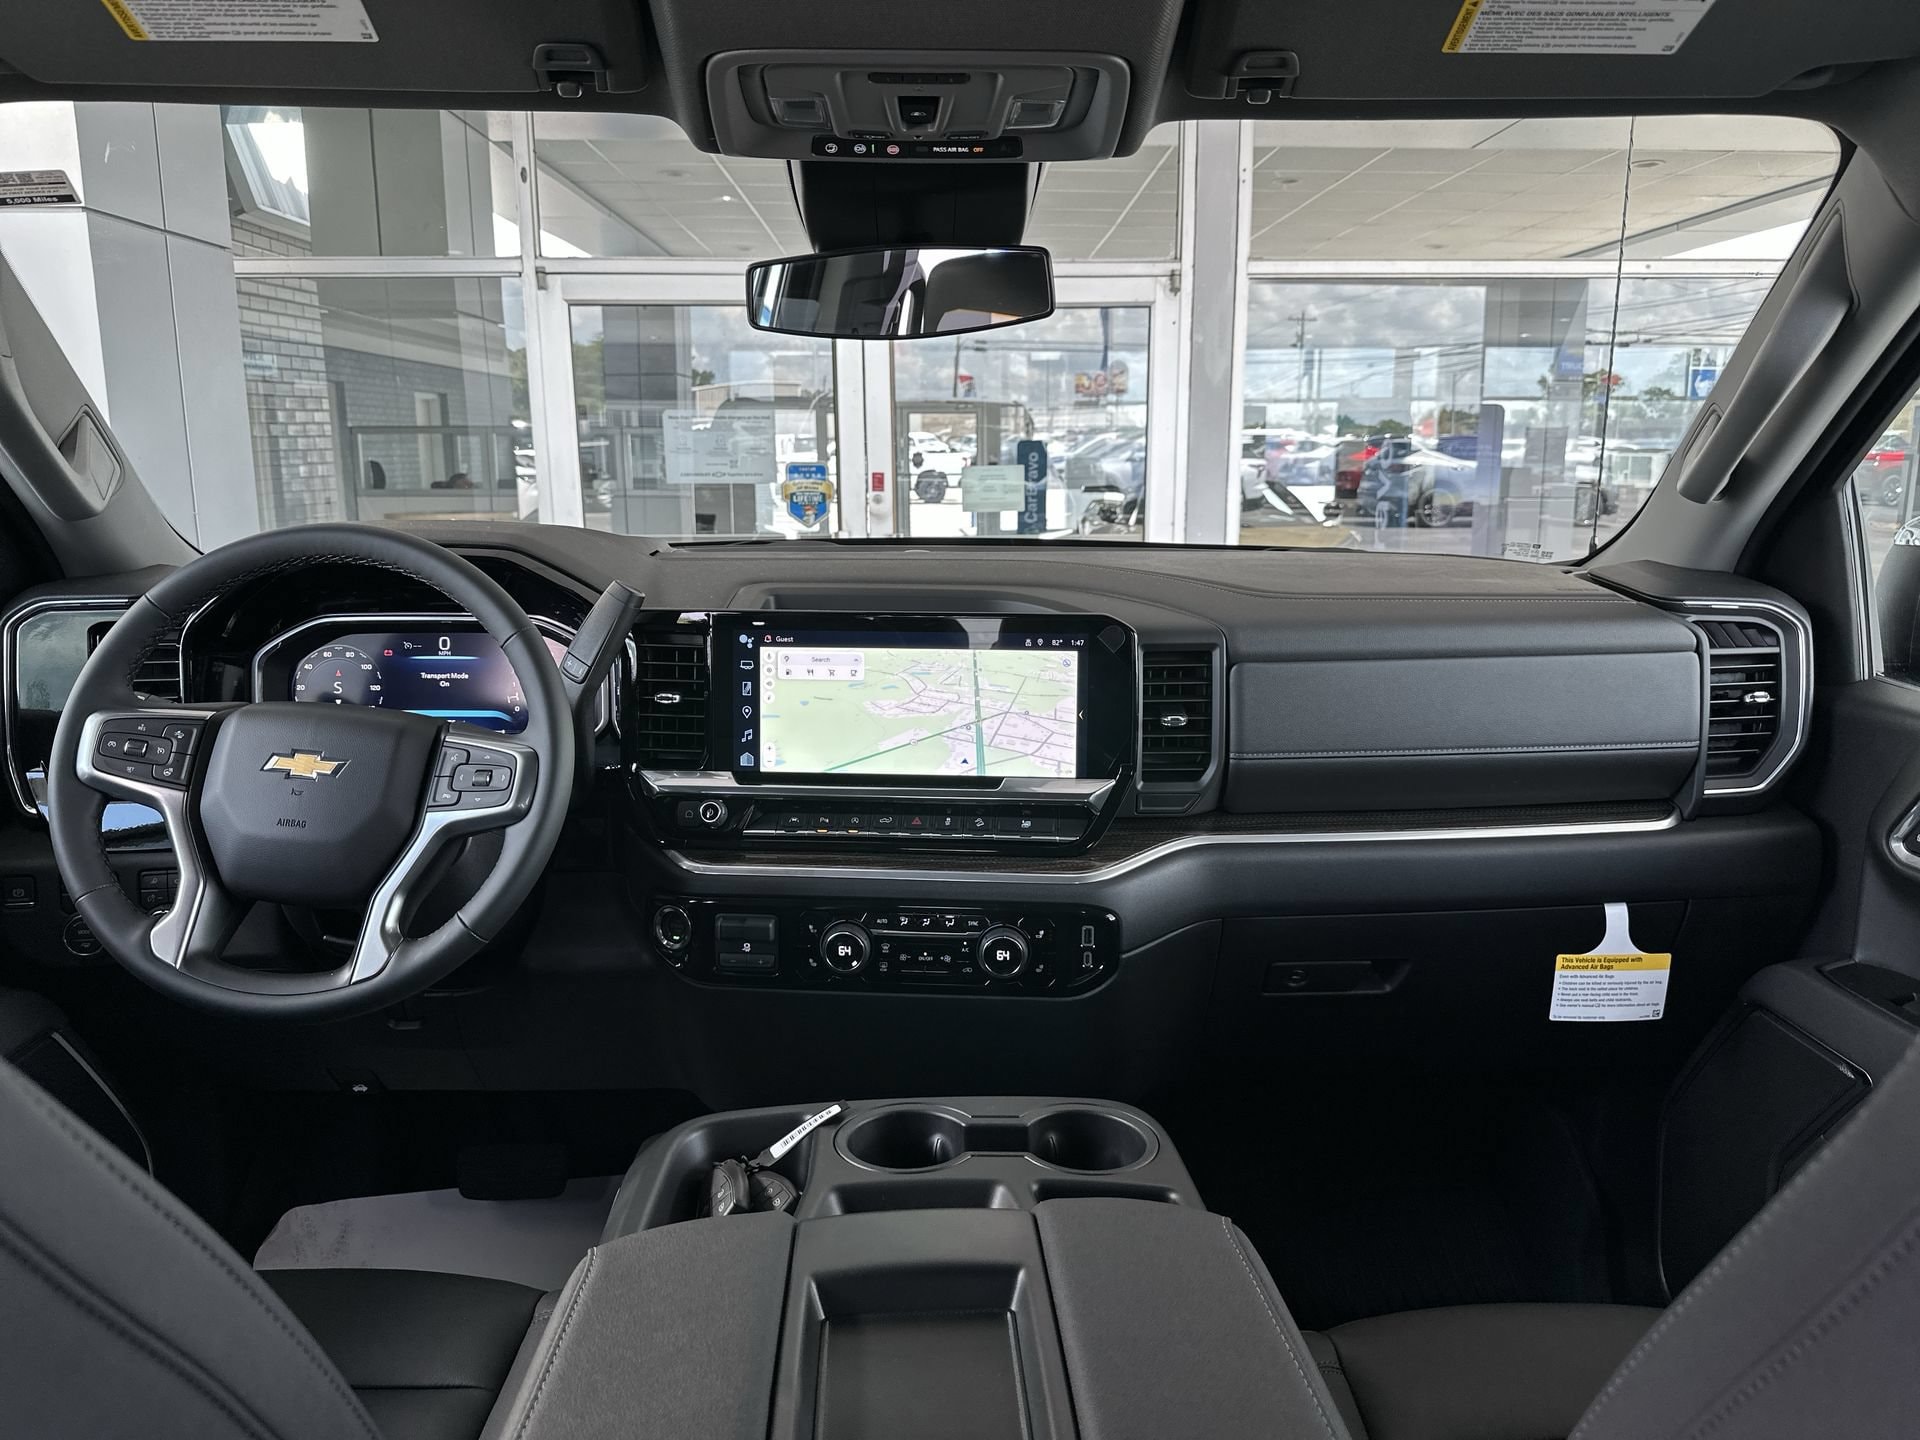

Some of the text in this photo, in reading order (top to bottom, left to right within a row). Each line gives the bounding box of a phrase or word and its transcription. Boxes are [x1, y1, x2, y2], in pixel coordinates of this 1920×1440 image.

[439, 636, 451, 651] 0
[420, 672, 450, 680] Transport
[333, 681, 343, 694] S
[276, 817, 307, 829] AIRBAG
[838, 945, 851, 956] 64
[996, 950, 1010, 961] 64
[1603, 956, 1630, 964] Equipped
[1600, 963, 1614, 971] Bags
